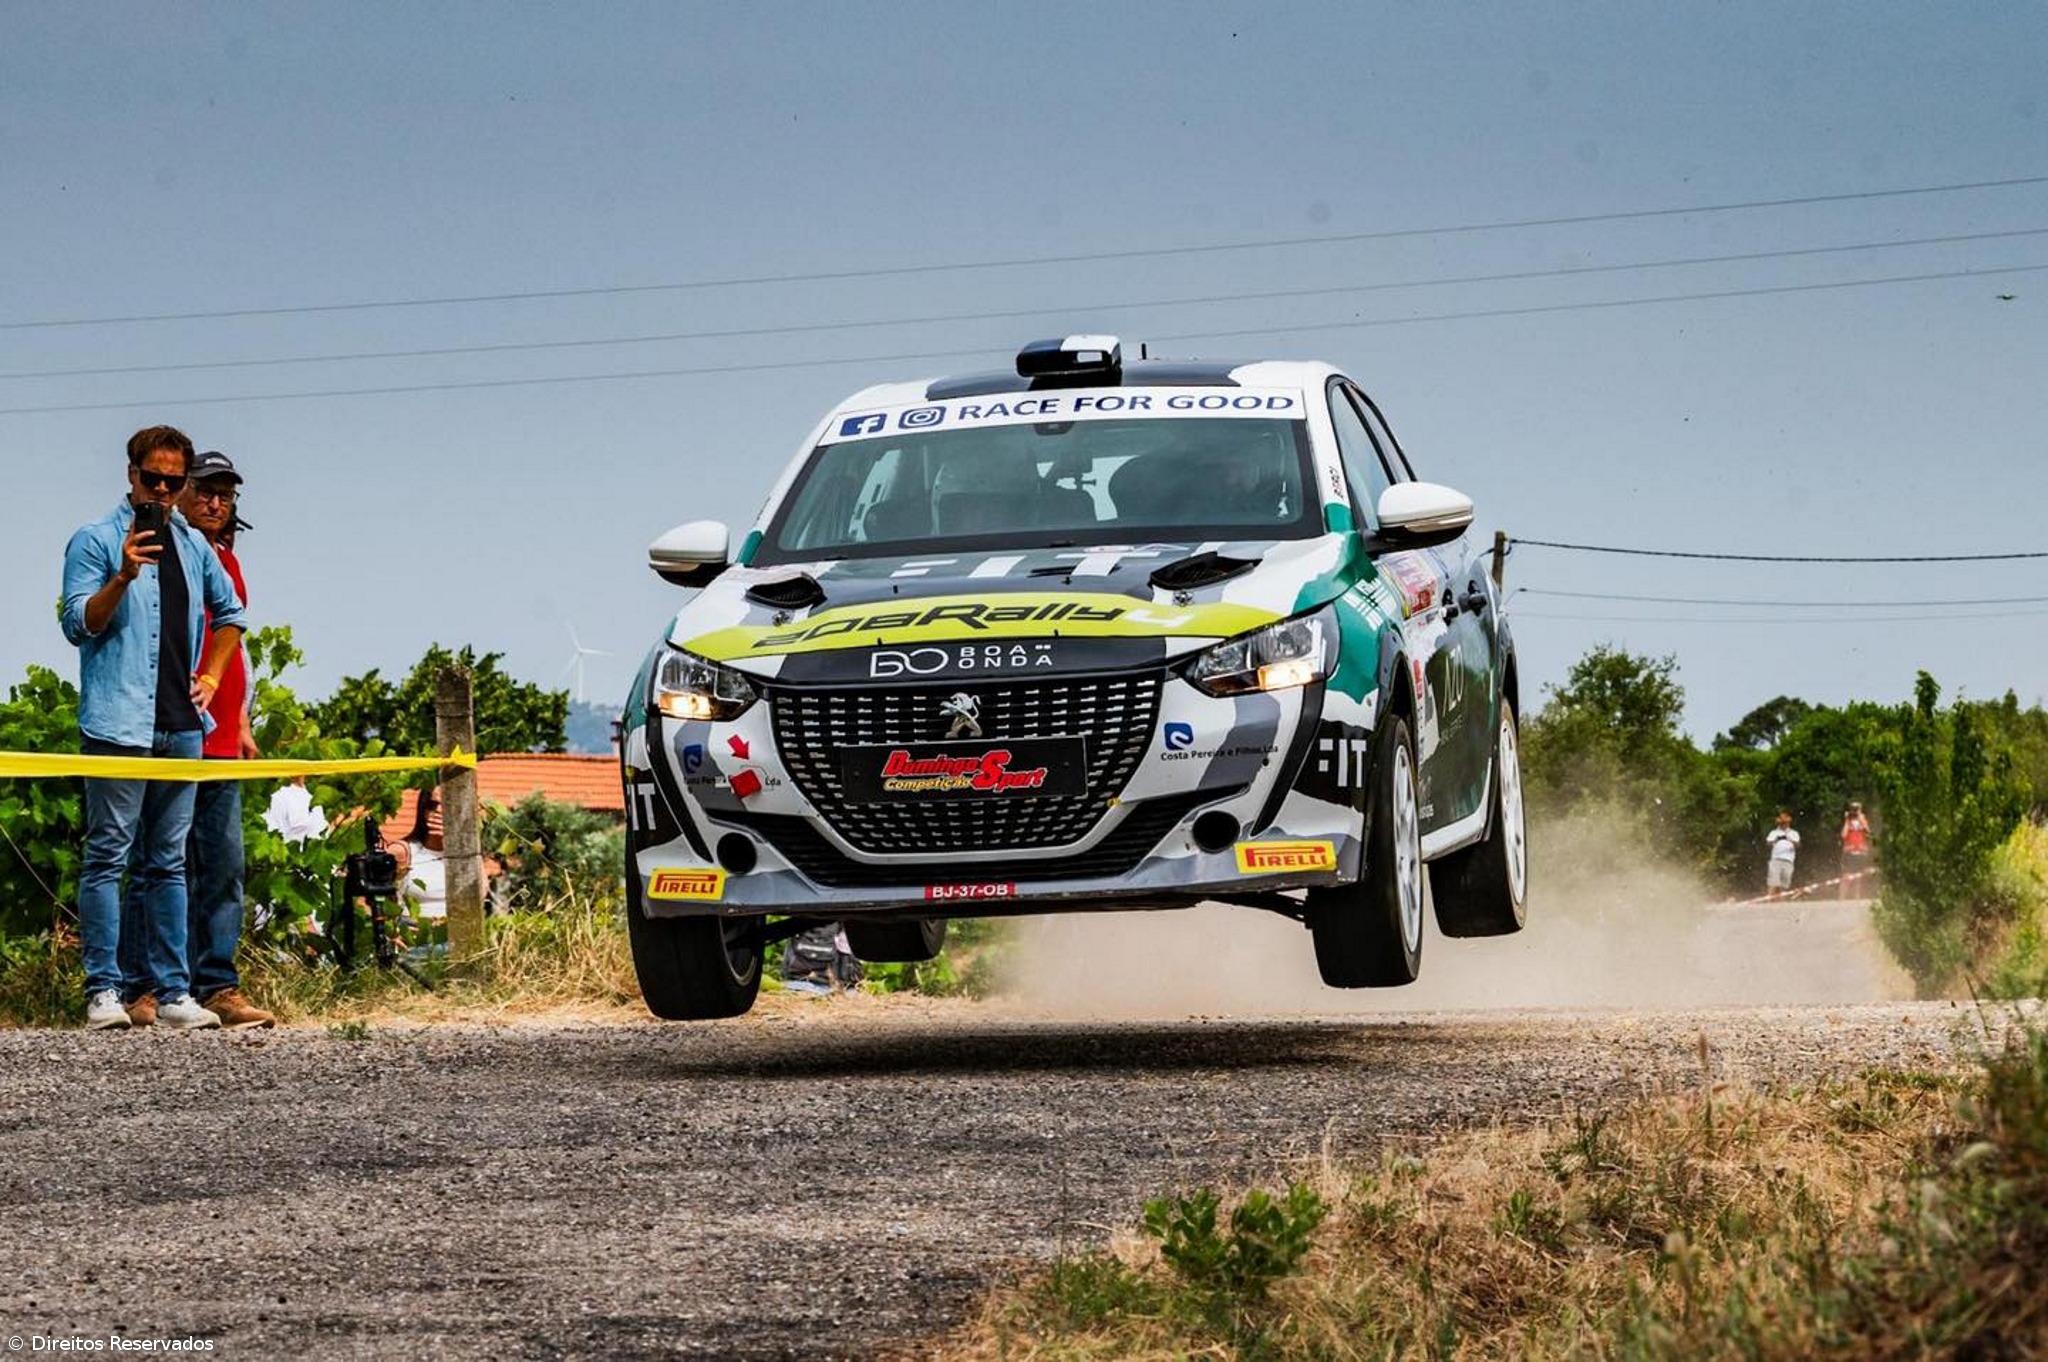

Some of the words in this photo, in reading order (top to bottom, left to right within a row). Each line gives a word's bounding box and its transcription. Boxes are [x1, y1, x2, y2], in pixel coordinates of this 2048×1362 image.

[959, 398, 1060, 420] RACE
[1073, 395, 1151, 412] FOR
[1167, 394, 1295, 411] GOOD
[960, 645, 1026, 658] BOA
[958, 655, 1053, 669] ONDA
[1160, 751, 1189, 761] Costa
[1319, 738, 1367, 788] FIT
[1245, 846, 1327, 868] PIRELLI
[654, 873, 718, 894] PIRELLI
[932, 884, 1009, 898] BJ-37-OB
